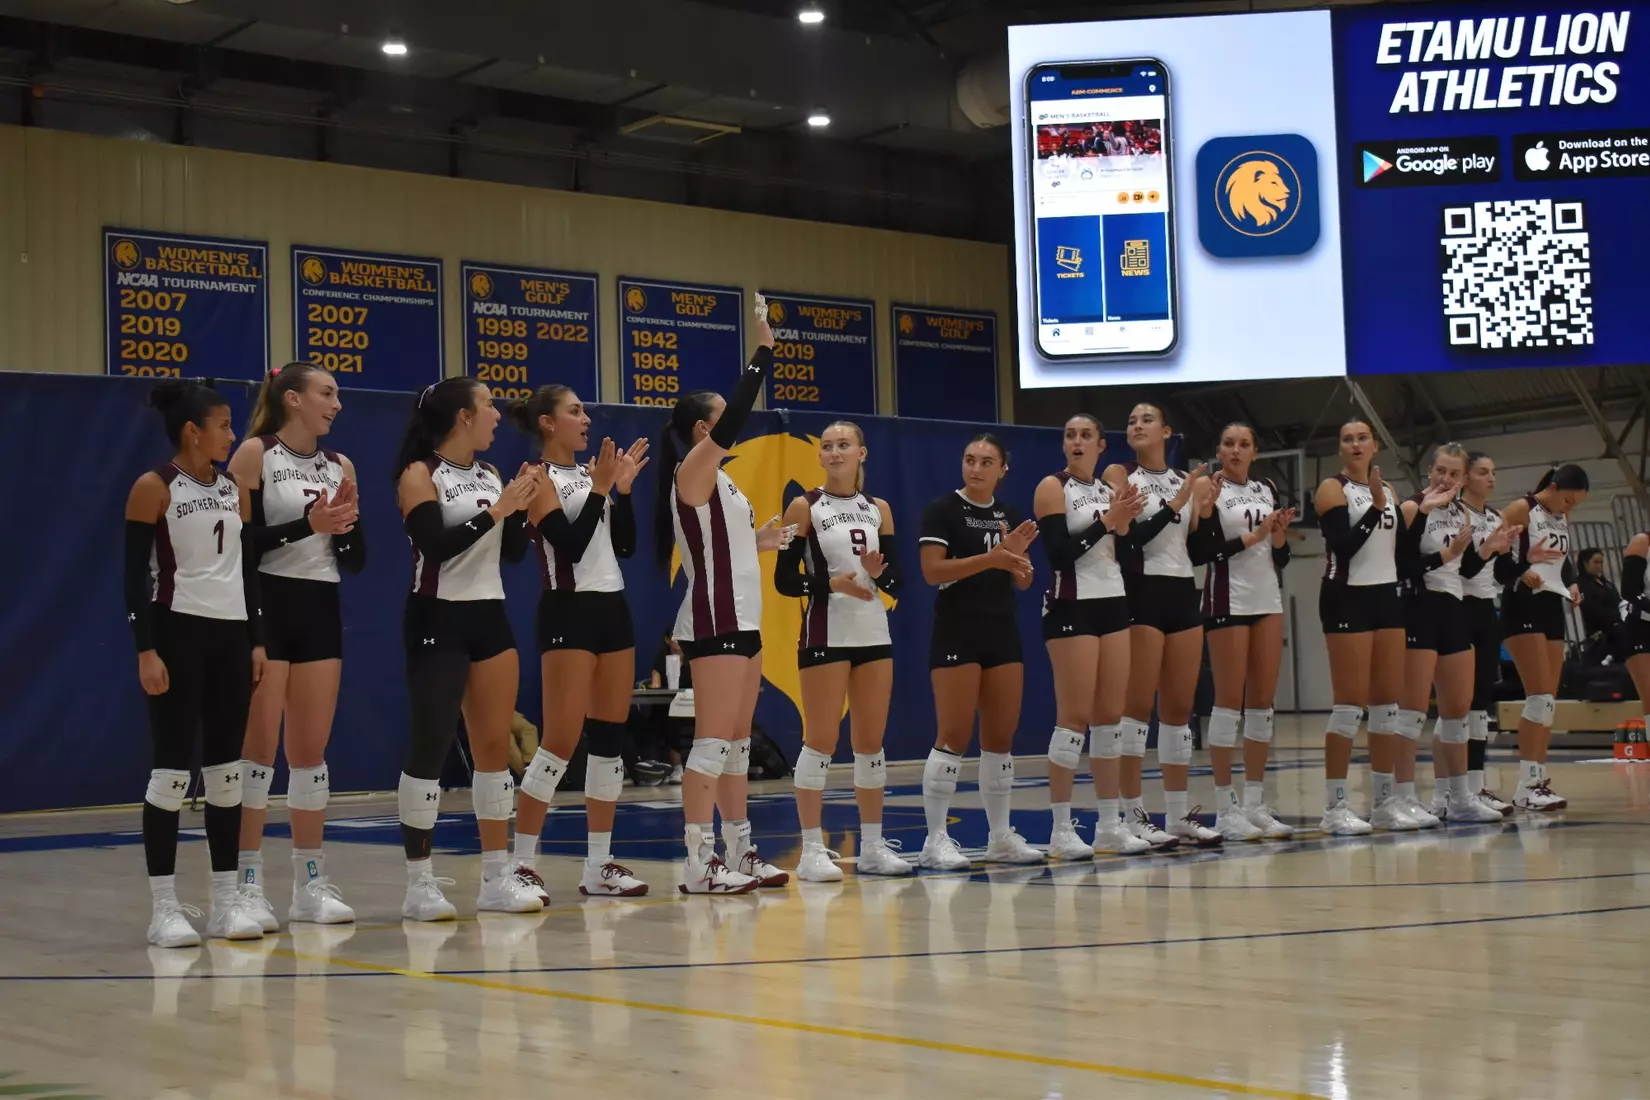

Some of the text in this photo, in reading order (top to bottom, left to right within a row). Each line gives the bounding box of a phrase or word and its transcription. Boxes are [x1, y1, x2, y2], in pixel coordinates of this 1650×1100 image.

[1376, 11, 1630, 64] ETAMU LION
[1389, 61, 1620, 113] ATHLETICS
[1559, 136, 1648, 149] Download on the
[1396, 153, 1495, 175] Google play
[1559, 150, 1650, 173] App Store
[158, 246, 250, 266] WOMEN'S
[145, 257, 262, 279] BASKETBALL
[340, 261, 424, 280] WOMEN'S
[1121, 269, 1150, 277] NEWS
[117, 272, 257, 294] NCAA TOURNAMENT
[329, 272, 437, 292] BASKETBALL
[520, 279, 570, 294] MEN'S
[120, 289, 187, 312] 2007
[302, 288, 434, 306] CONFERENCE CHAMPIONSHIPS
[525, 291, 565, 304] GOLF
[671, 291, 717, 307] MEN'S
[308, 304, 368, 325] 2007
[473, 302, 589, 321] NCAA TOURNAMENT
[676, 303, 712, 317] GOLF
[798, 305, 862, 322] WOMEN'S
[121, 314, 181, 337] 2019
[476, 317, 589, 342] 1998 2022
[626, 315, 736, 332] CONFERENCE CHAMPIONSHIPS
[813, 317, 848, 330] GOLF
[925, 316, 984, 331] WOMEN'S
[940, 326, 972, 339] GOLF
[308, 327, 369, 350] 2020
[632, 330, 678, 349] 1942
[772, 327, 868, 345] NCAA TOURNAMENT
[121, 340, 188, 362] 2020
[477, 340, 528, 361] 1999
[773, 341, 815, 361] 2019
[308, 351, 363, 373] 2021
[632, 352, 679, 371] 1964
[773, 362, 815, 381] 2021
[477, 363, 528, 383] 2001
[633, 374, 679, 393] 1965
[774, 383, 820, 402] 2022
[273, 468, 309, 484] SOUTHERN
[176, 497, 220, 519] SOUTHERN
[821, 512, 855, 531] SOUTHERN
[1244, 509, 1266, 532] 14
[213, 520, 225, 554] 1
[849, 529, 867, 556] 9
[1550, 533, 1568, 555] 20
